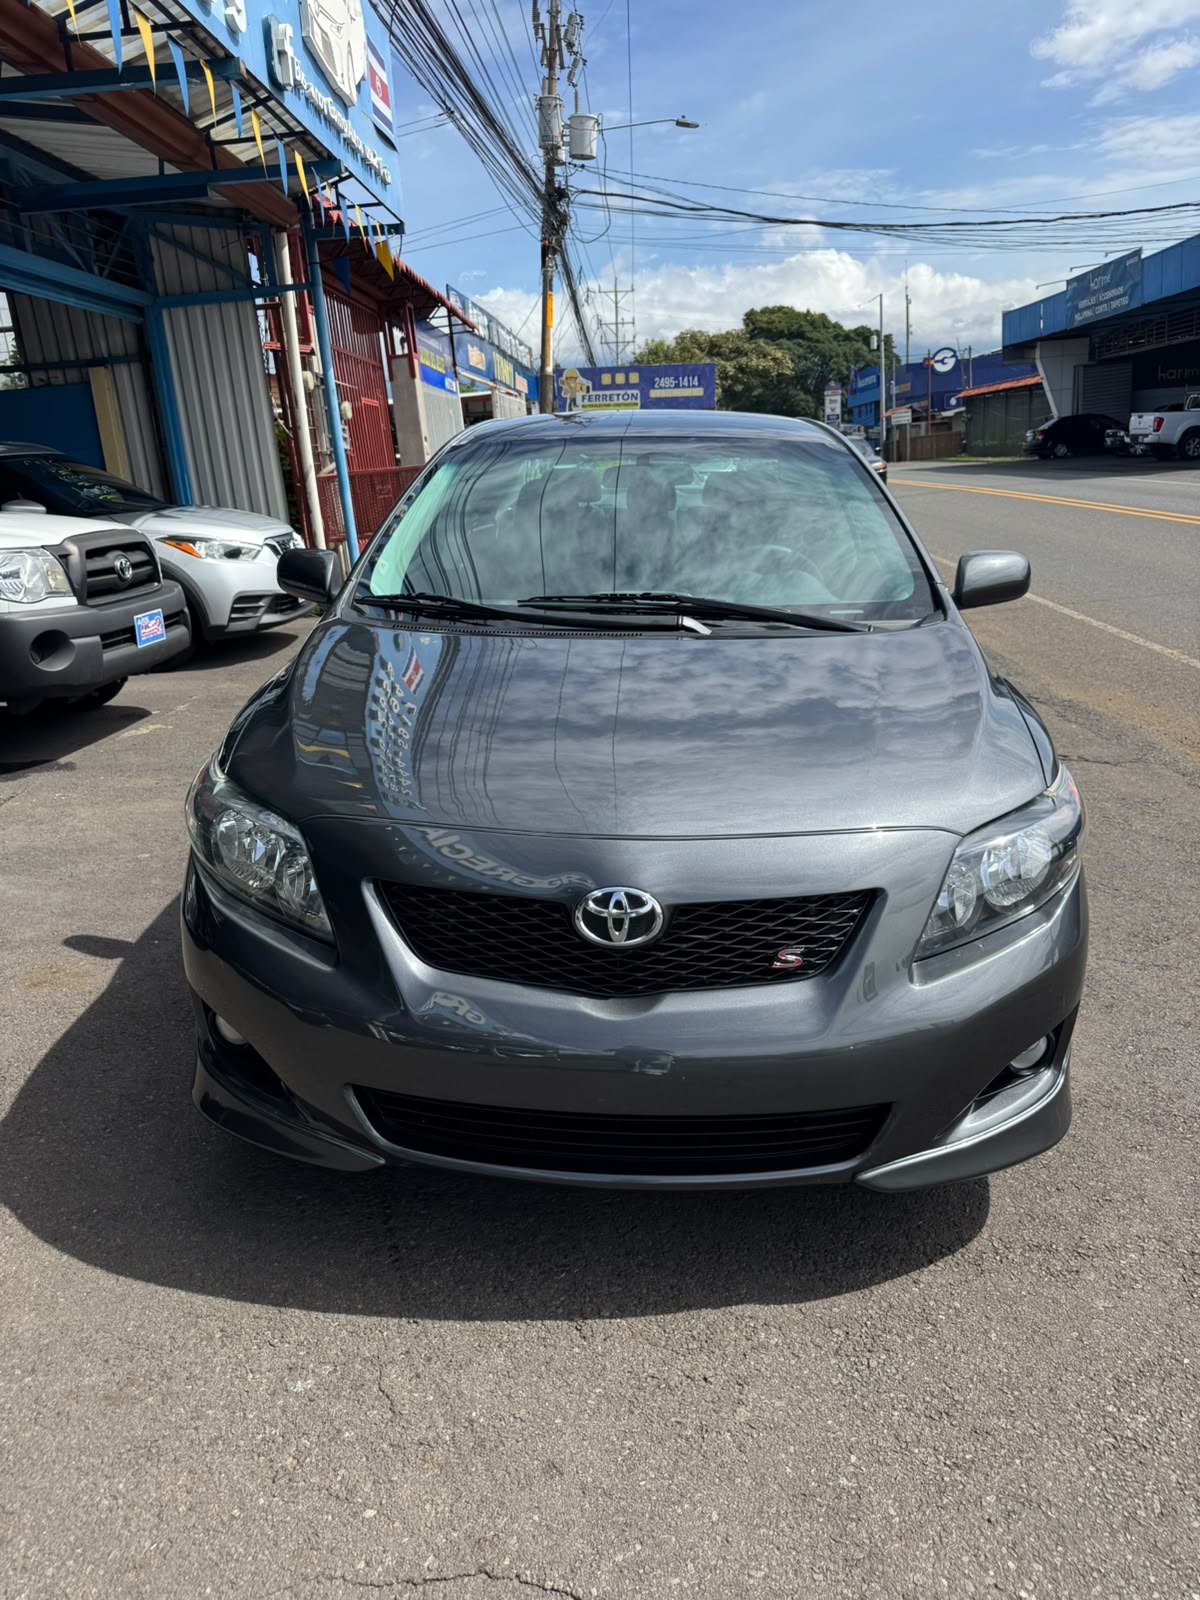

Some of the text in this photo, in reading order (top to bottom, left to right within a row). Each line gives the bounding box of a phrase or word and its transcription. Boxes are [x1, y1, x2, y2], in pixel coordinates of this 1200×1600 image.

[654, 375, 699, 389] 2495-1414
[581, 391, 639, 403] FERRETÓN
[771, 947, 805, 969] S
